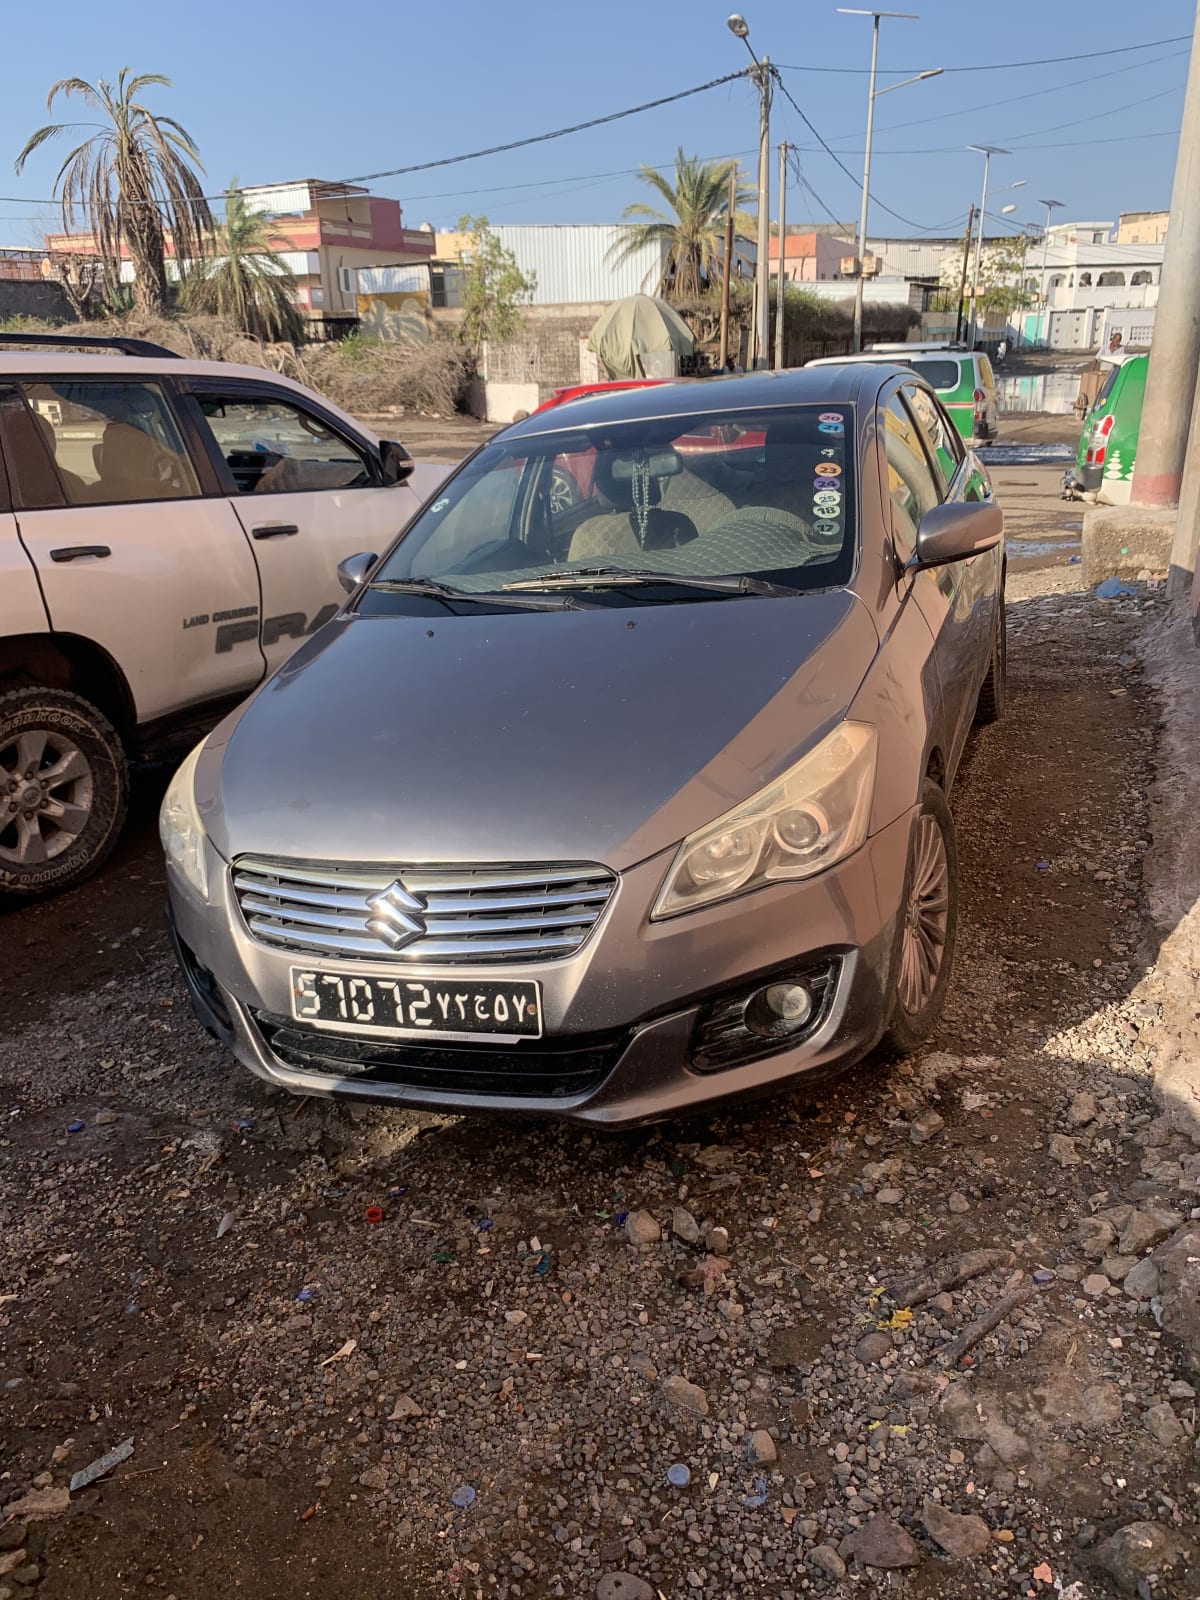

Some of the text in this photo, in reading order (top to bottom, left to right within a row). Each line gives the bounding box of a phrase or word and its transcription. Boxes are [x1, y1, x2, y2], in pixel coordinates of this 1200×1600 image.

[819, 466, 838, 474] 23
[817, 480, 838, 488] 24
[819, 495, 837, 503] 25
[817, 506, 837, 515] 18
[816, 524, 834, 532] 17
[183, 606, 258, 629] LAND CRUISER
